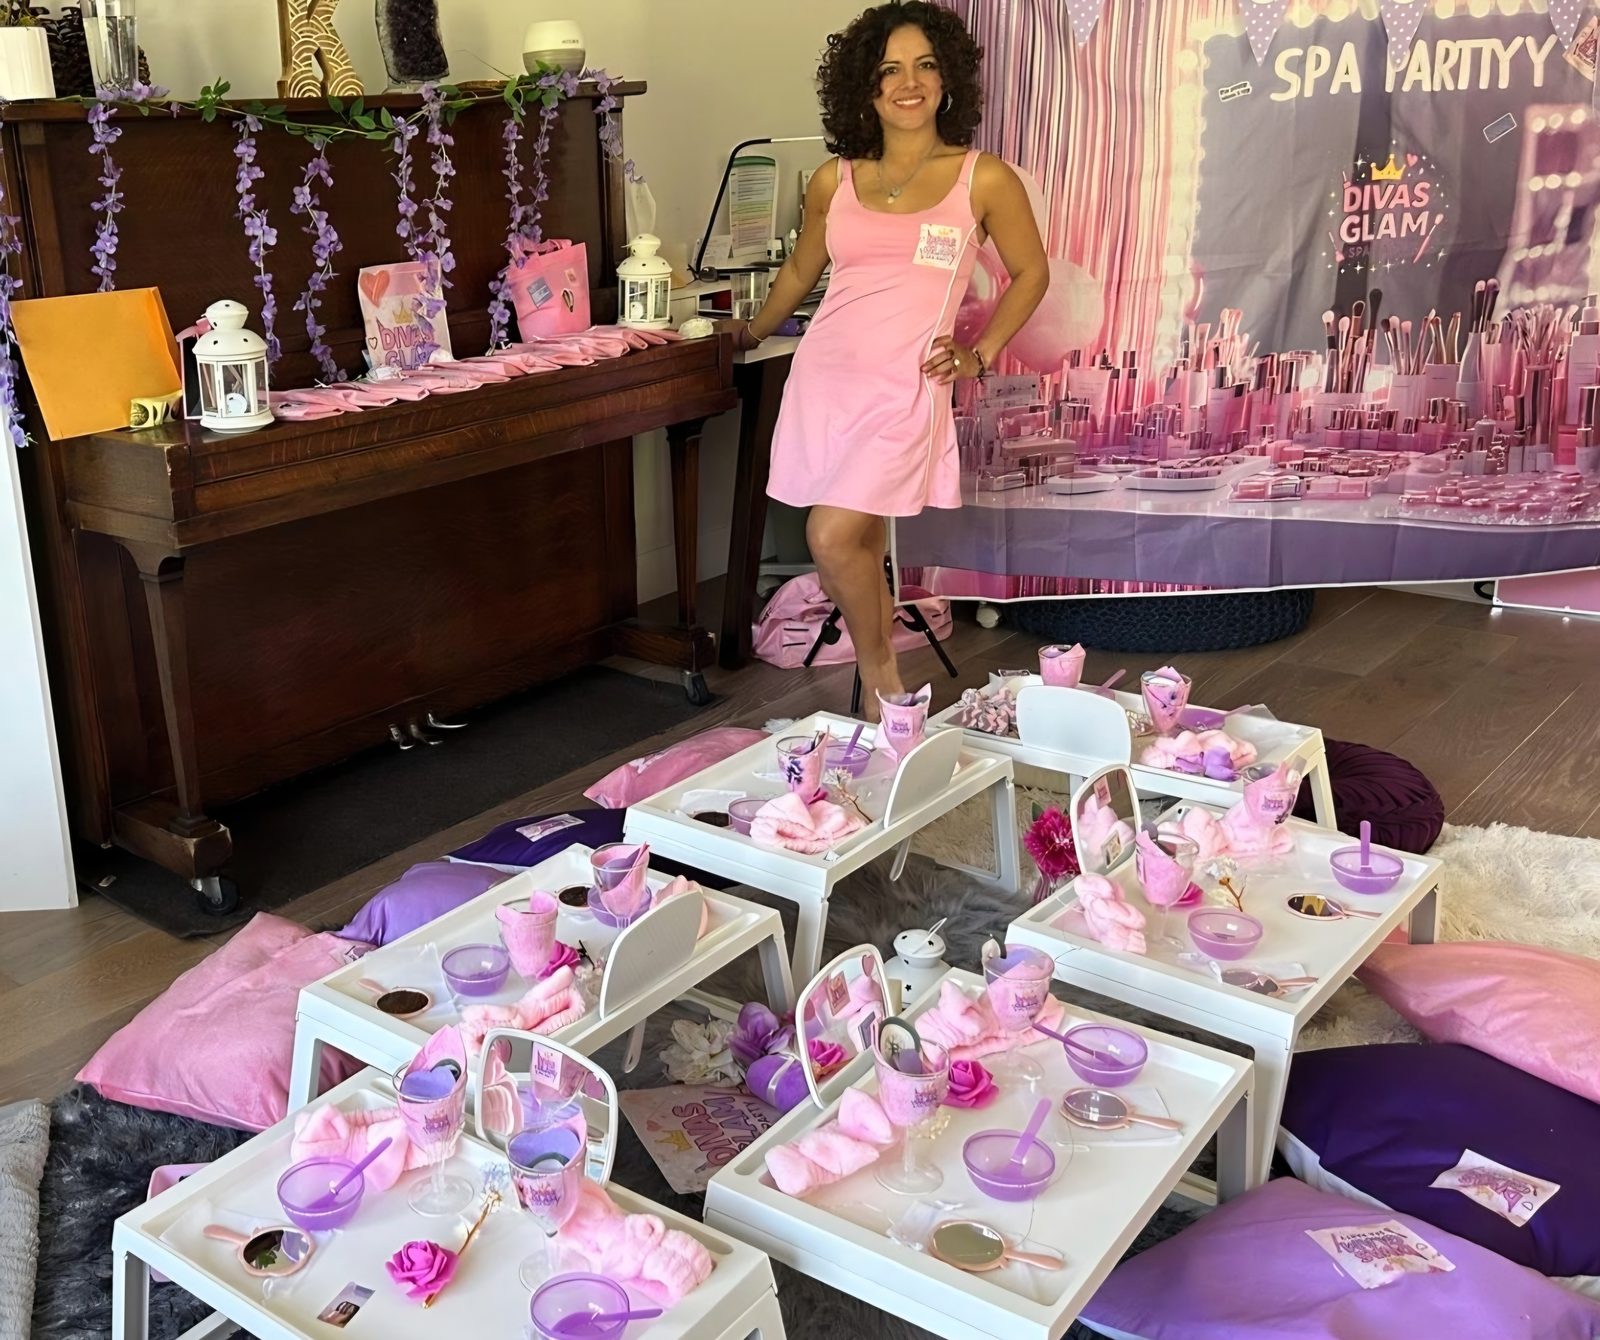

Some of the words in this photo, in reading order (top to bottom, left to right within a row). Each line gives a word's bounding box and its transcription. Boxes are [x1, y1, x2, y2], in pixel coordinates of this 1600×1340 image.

[1270, 42, 1362, 101] SPA
[1343, 182, 1431, 213] DIVAS
[1340, 211, 1430, 243] GLAM
[703, 1096, 764, 1151] LAM
